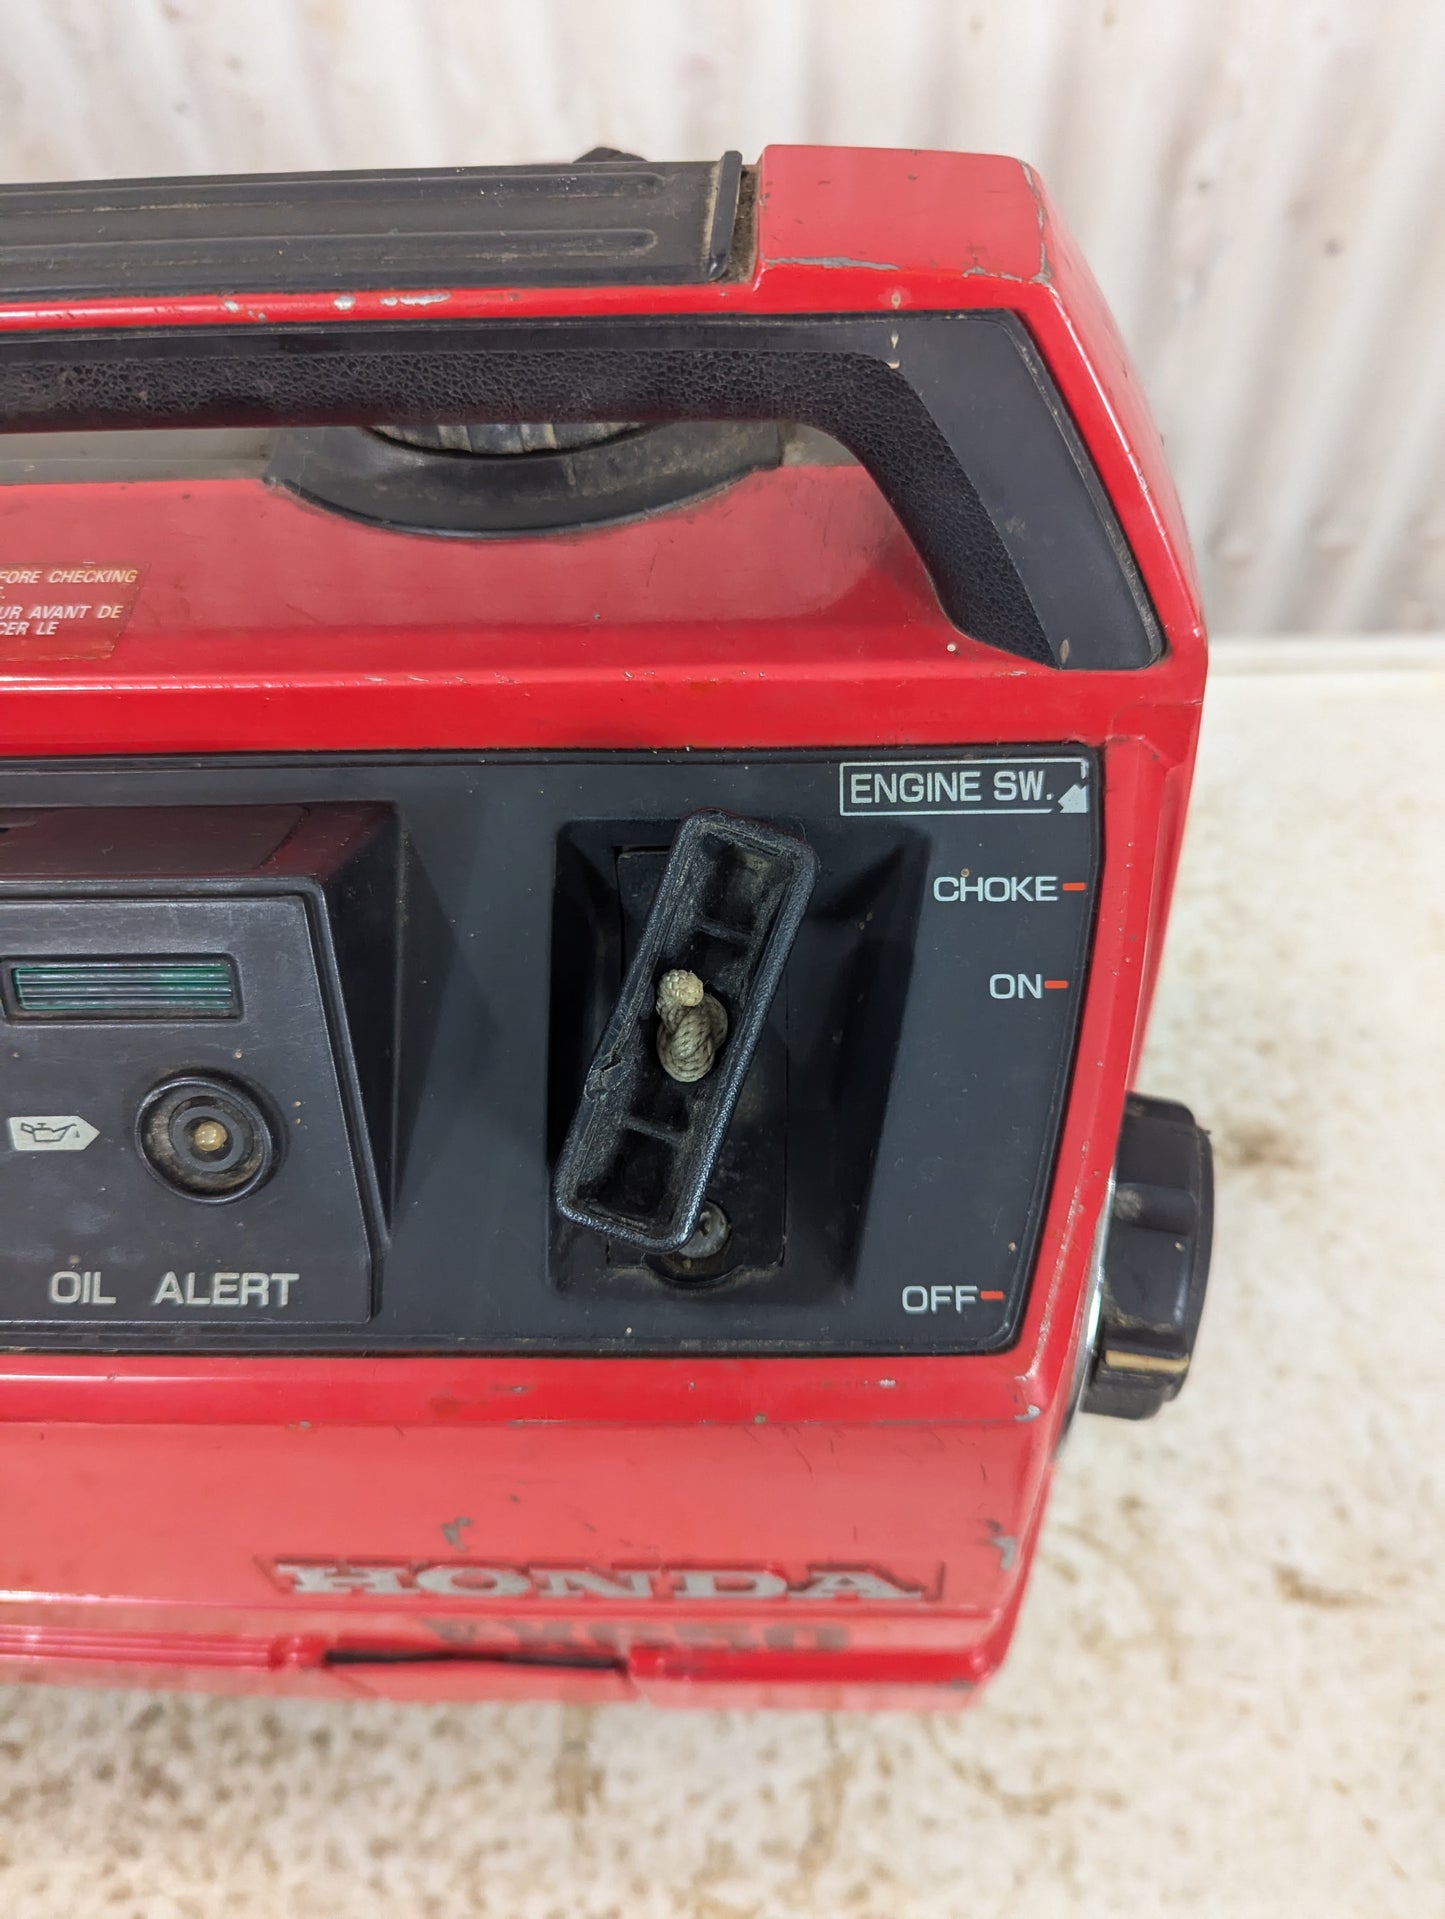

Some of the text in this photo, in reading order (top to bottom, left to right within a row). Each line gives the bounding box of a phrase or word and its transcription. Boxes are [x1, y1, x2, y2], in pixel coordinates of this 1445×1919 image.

[48, 569, 138, 584] CHECKING
[28, 605, 92, 619] AVANT
[97, 605, 124, 619] DE
[35, 621, 59, 635] LE
[851, 770, 1053, 803] ENGINE SW.
[933, 876, 1059, 902] CHOKE
[989, 973, 1042, 999] ON
[50, 1271, 300, 1307] OIL ALERT
[902, 1285, 978, 1313] OFF
[276, 1559, 926, 1600] HONDA
